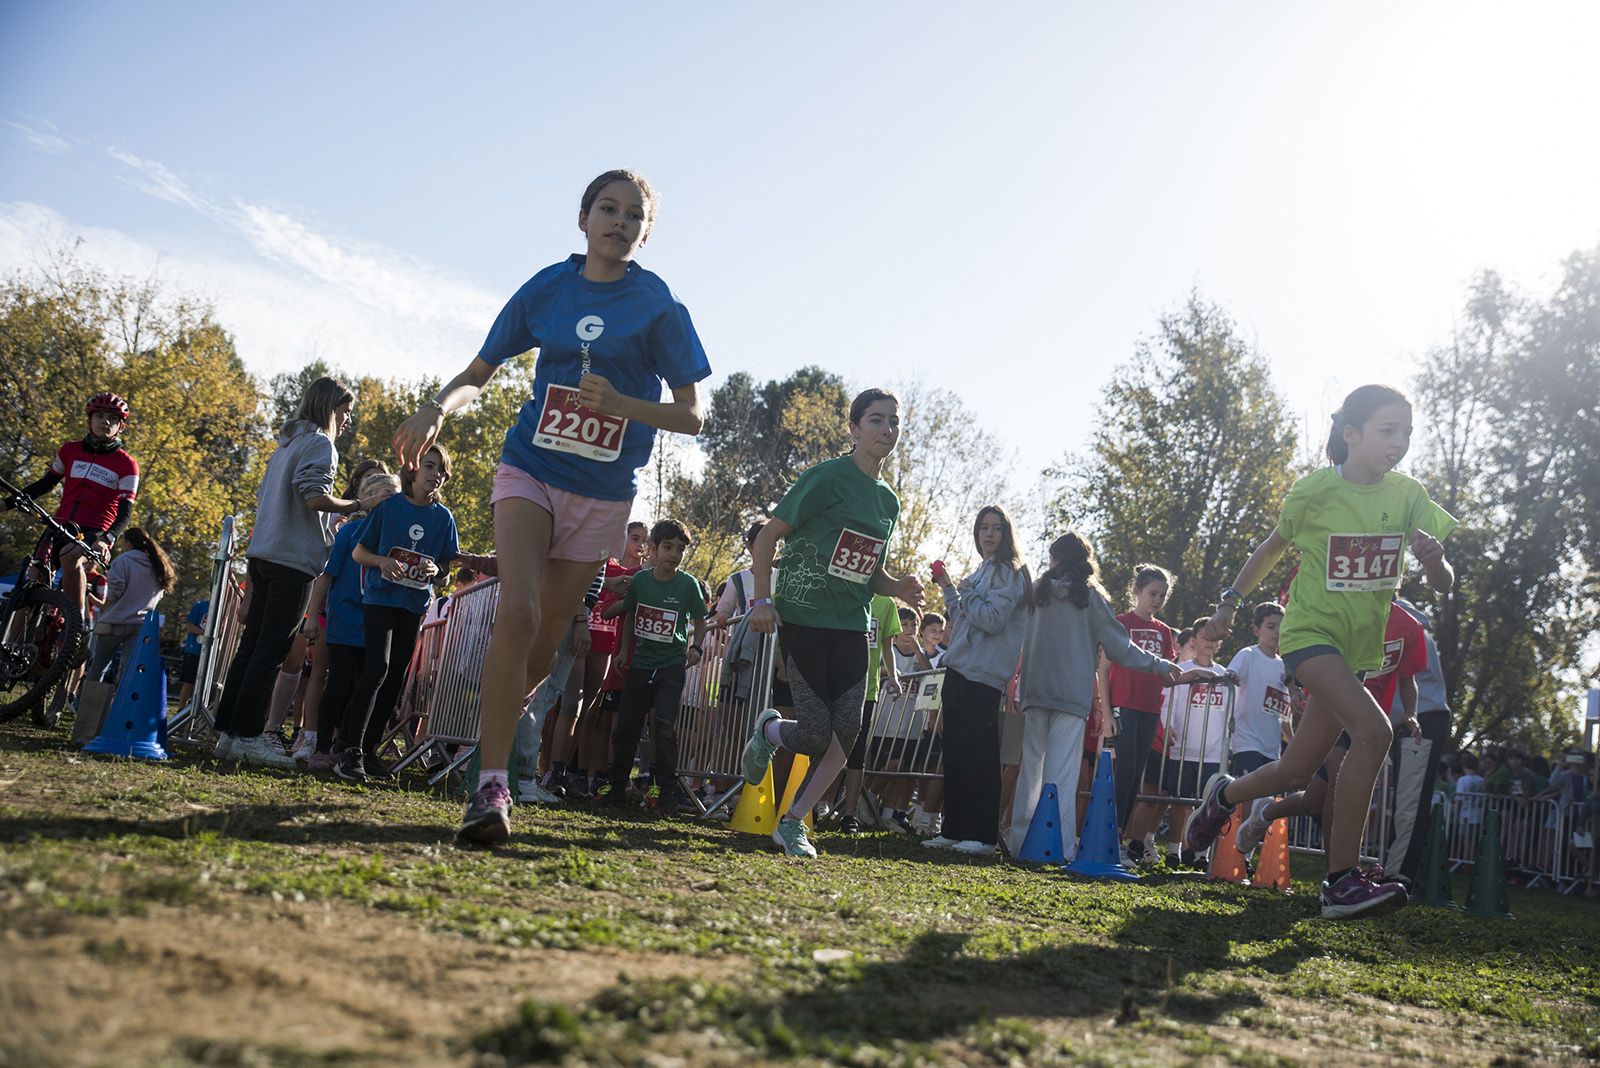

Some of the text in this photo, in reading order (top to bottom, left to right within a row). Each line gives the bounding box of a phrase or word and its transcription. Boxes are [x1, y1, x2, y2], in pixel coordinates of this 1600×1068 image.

[543, 409, 619, 447] 2207
[836, 548, 877, 574] 3372
[1333, 554, 1397, 578] 3147
[637, 616, 673, 636] 3362
[1139, 640, 1162, 653] 739
[1265, 697, 1290, 717] 4217
